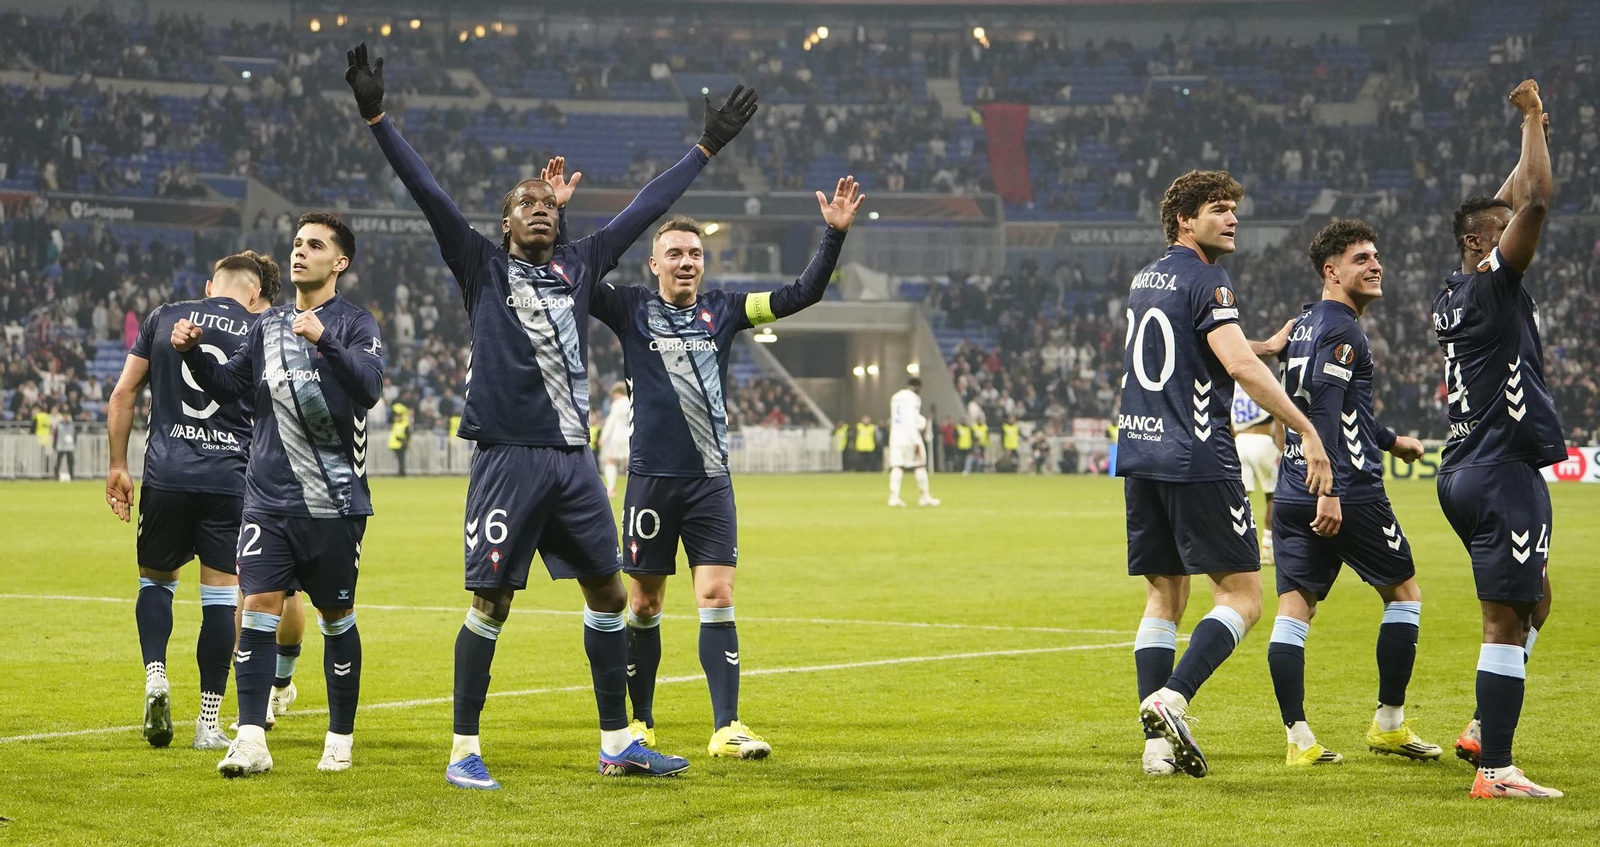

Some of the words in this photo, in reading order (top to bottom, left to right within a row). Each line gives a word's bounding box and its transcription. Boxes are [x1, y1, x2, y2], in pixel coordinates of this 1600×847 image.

[352, 218, 388, 232] UEFA
[189, 311, 248, 336] JUTGLÀ
[1118, 414, 1165, 433] BANCA
[202, 442, 220, 451] Obra
[1127, 431, 1142, 441] Obra
[1143, 432, 1162, 442] Social
[485, 508, 508, 544] 6
[628, 506, 661, 540] 10
[1535, 523, 1549, 559] 4
